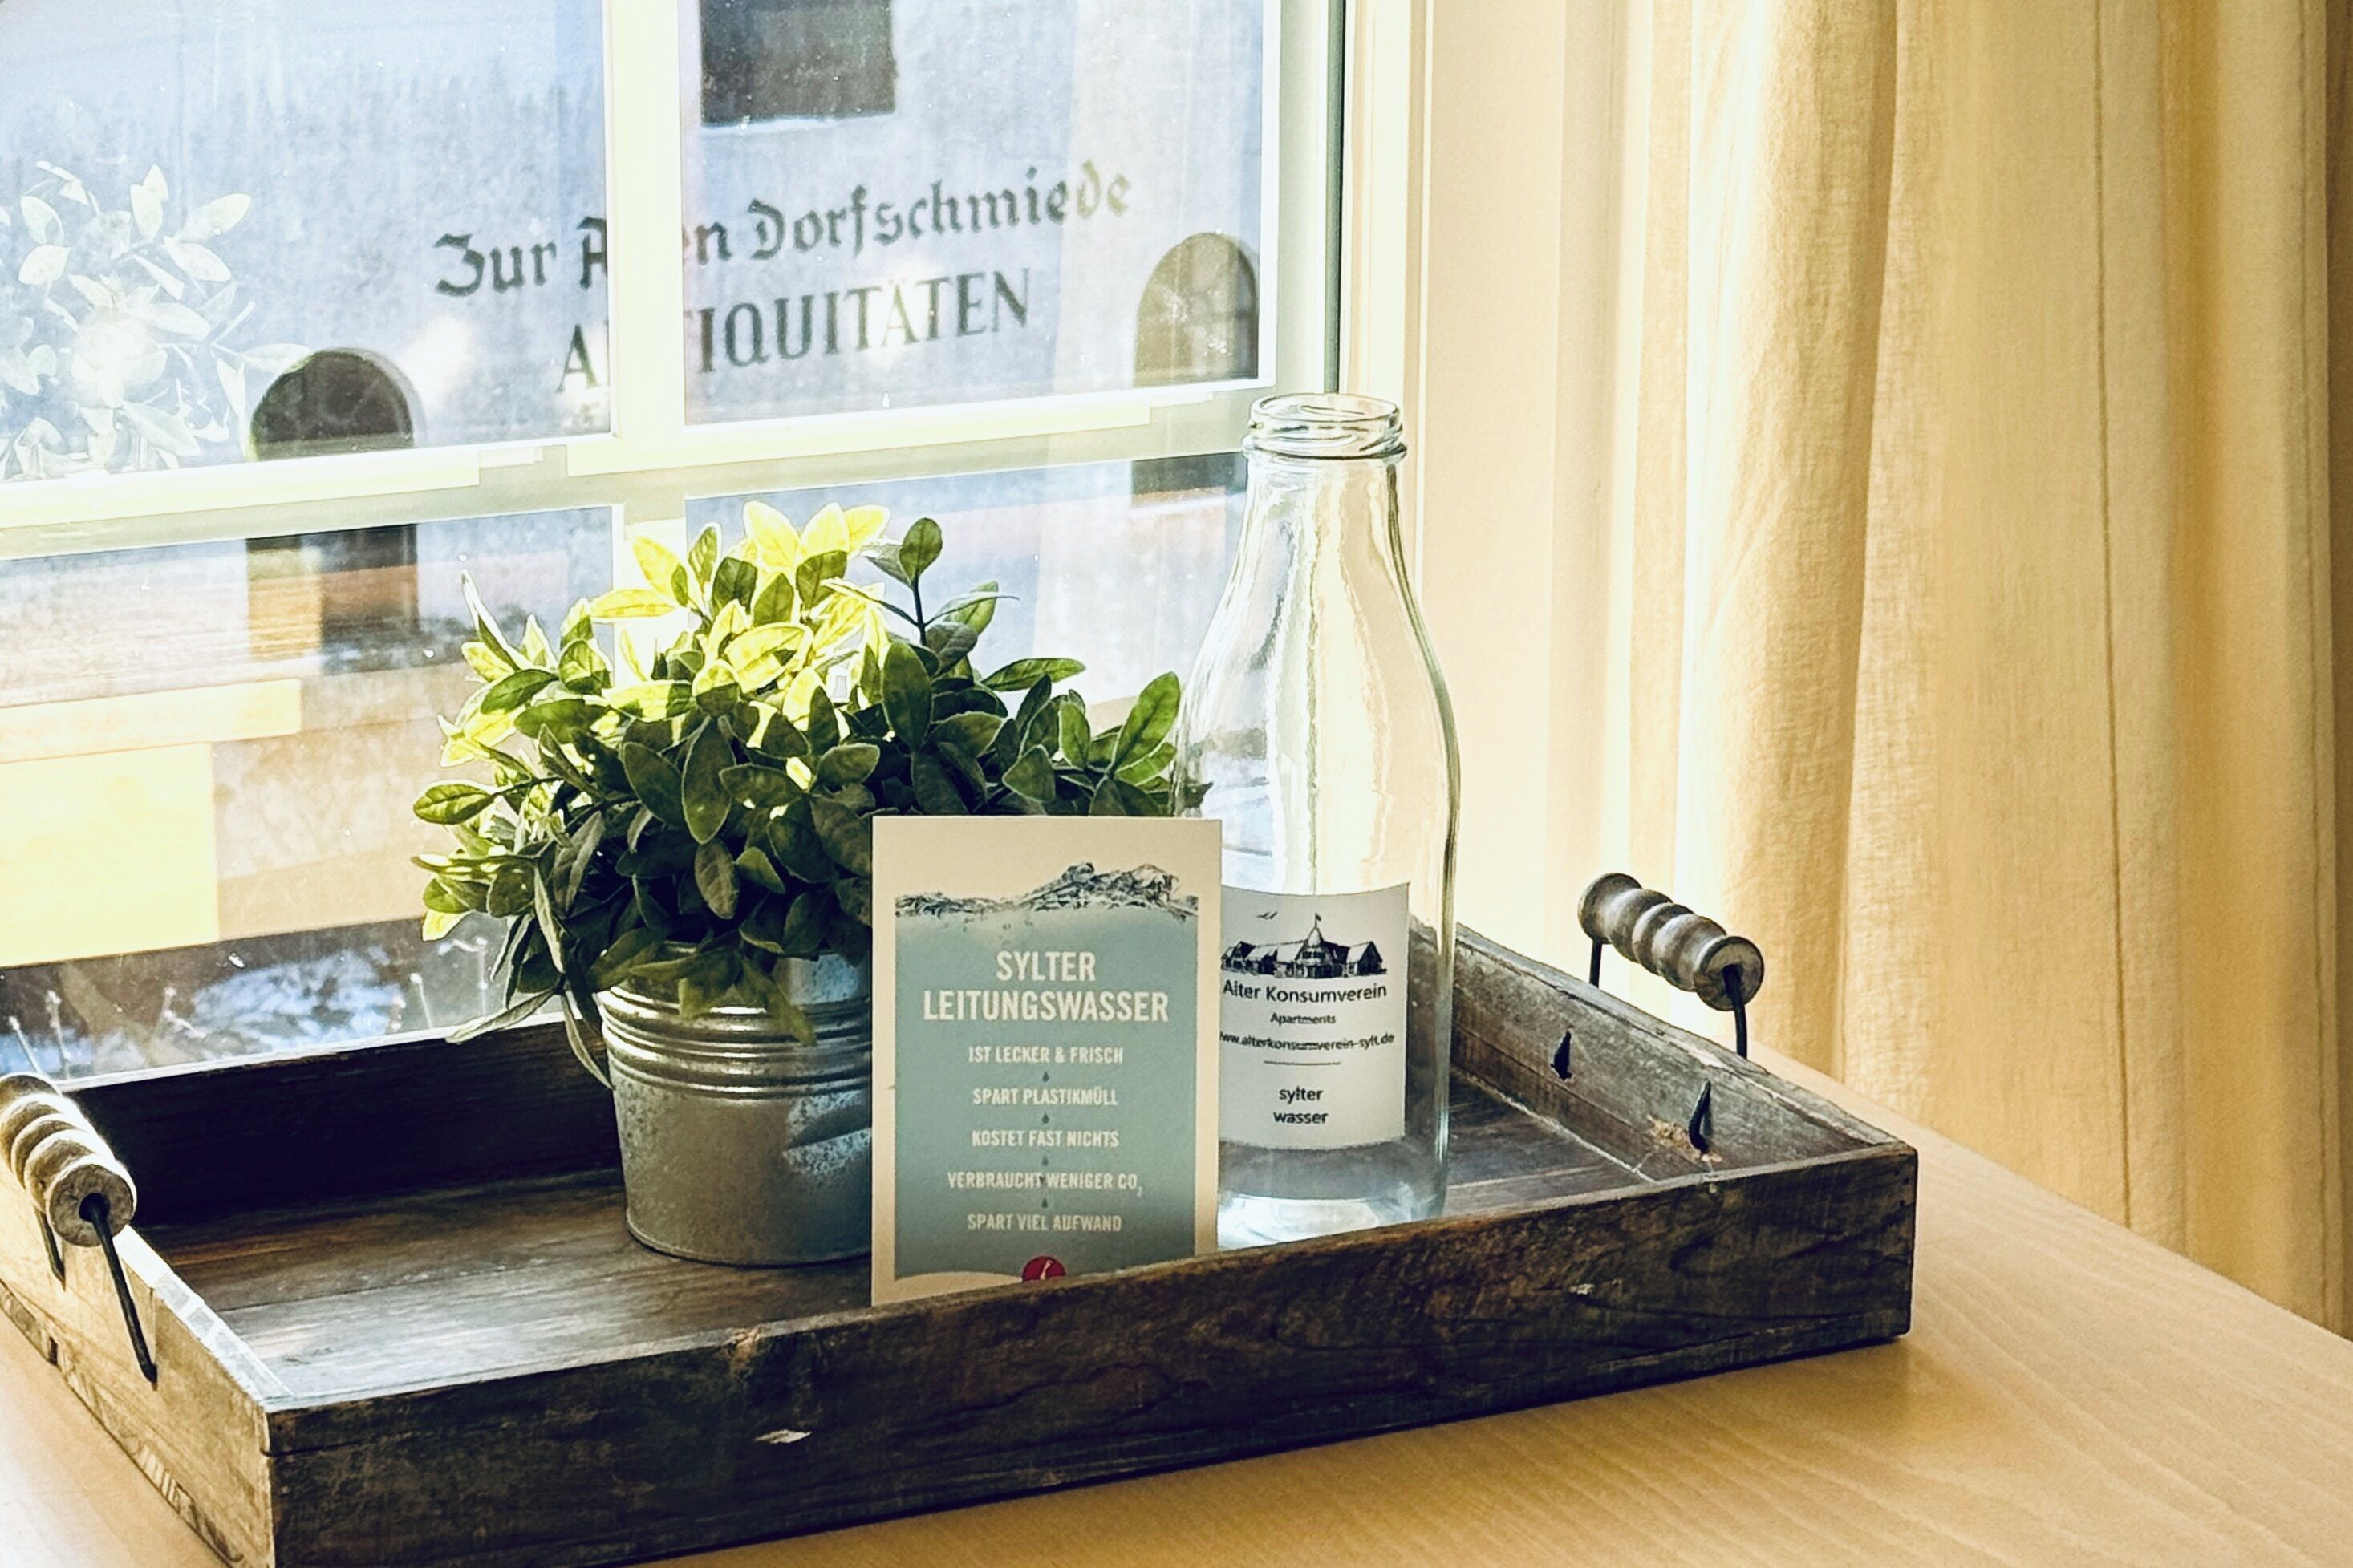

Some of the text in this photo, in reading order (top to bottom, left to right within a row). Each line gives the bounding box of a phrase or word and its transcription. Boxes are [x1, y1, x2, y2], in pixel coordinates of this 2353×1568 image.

[432, 231, 557, 298] Zur
[747, 159, 1130, 261] Dorfschmiede
[555, 268, 1030, 393] AIQUITÄTEN
[996, 950, 1096, 983] SYLTER
[1223, 979, 1387, 1003] Alter Konsumverein
[923, 990, 1170, 1023] LEITUNGSWASSER
[1269, 1011, 1337, 1026] Apartments
[968, 1047, 1123, 1064] IST LECKER & FRISCH
[972, 1087, 1118, 1106] SPART PLASTIKMÜLL
[1279, 1086, 1324, 1106] sylter
[1272, 1111, 1329, 1124] wasser
[972, 1129, 1119, 1148] KOSTET FAST NICHTS
[947, 1171, 1043, 1190] VERBRAUCHT
[1045, 1172, 1114, 1190] WENIGER
[967, 1213, 1122, 1233] SPART VIEL AUFWAND
